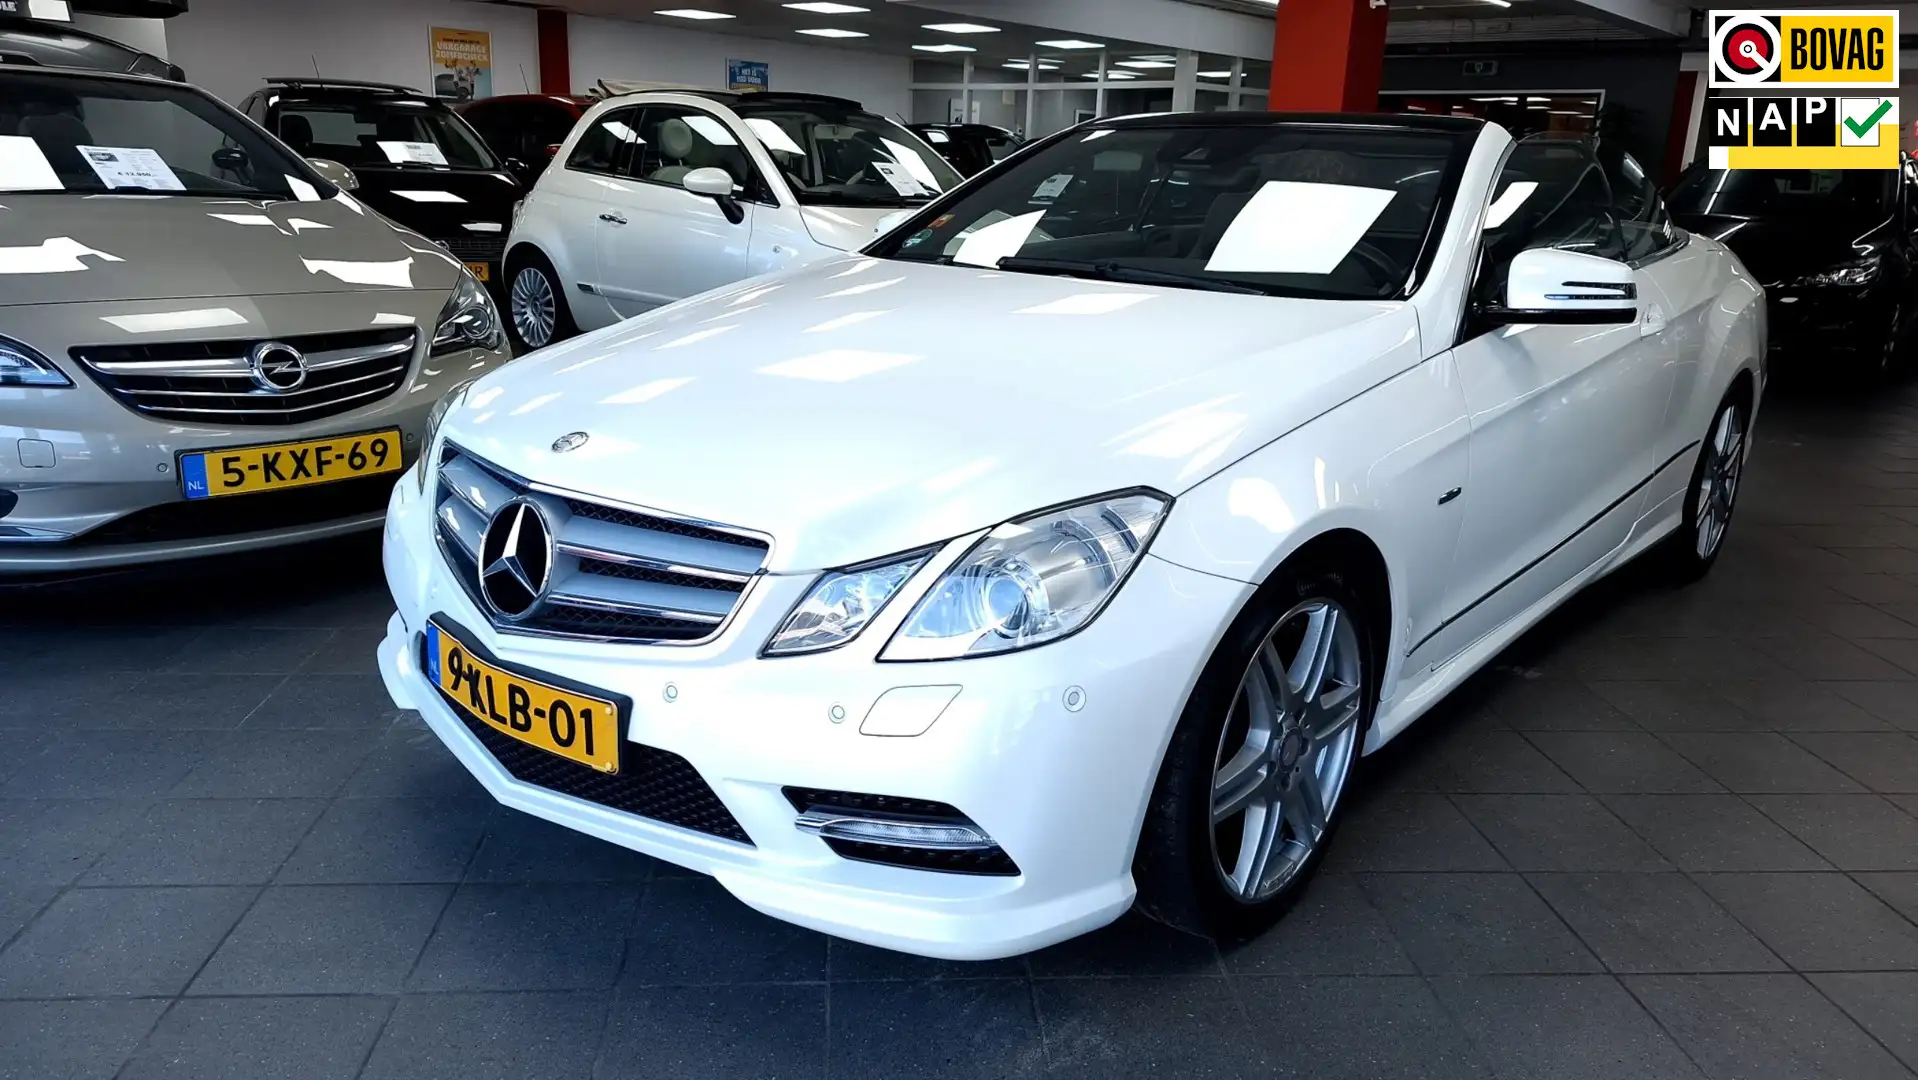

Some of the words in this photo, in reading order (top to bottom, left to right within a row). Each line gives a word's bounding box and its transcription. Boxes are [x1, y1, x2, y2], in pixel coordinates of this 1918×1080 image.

[0, 1, 17, 11] LE
[188, 481, 204, 491] NL
[222, 438, 388, 487] 5-KXF-69
[430, 659, 439, 676] NL
[448, 647, 594, 756] 9-KLB-01
